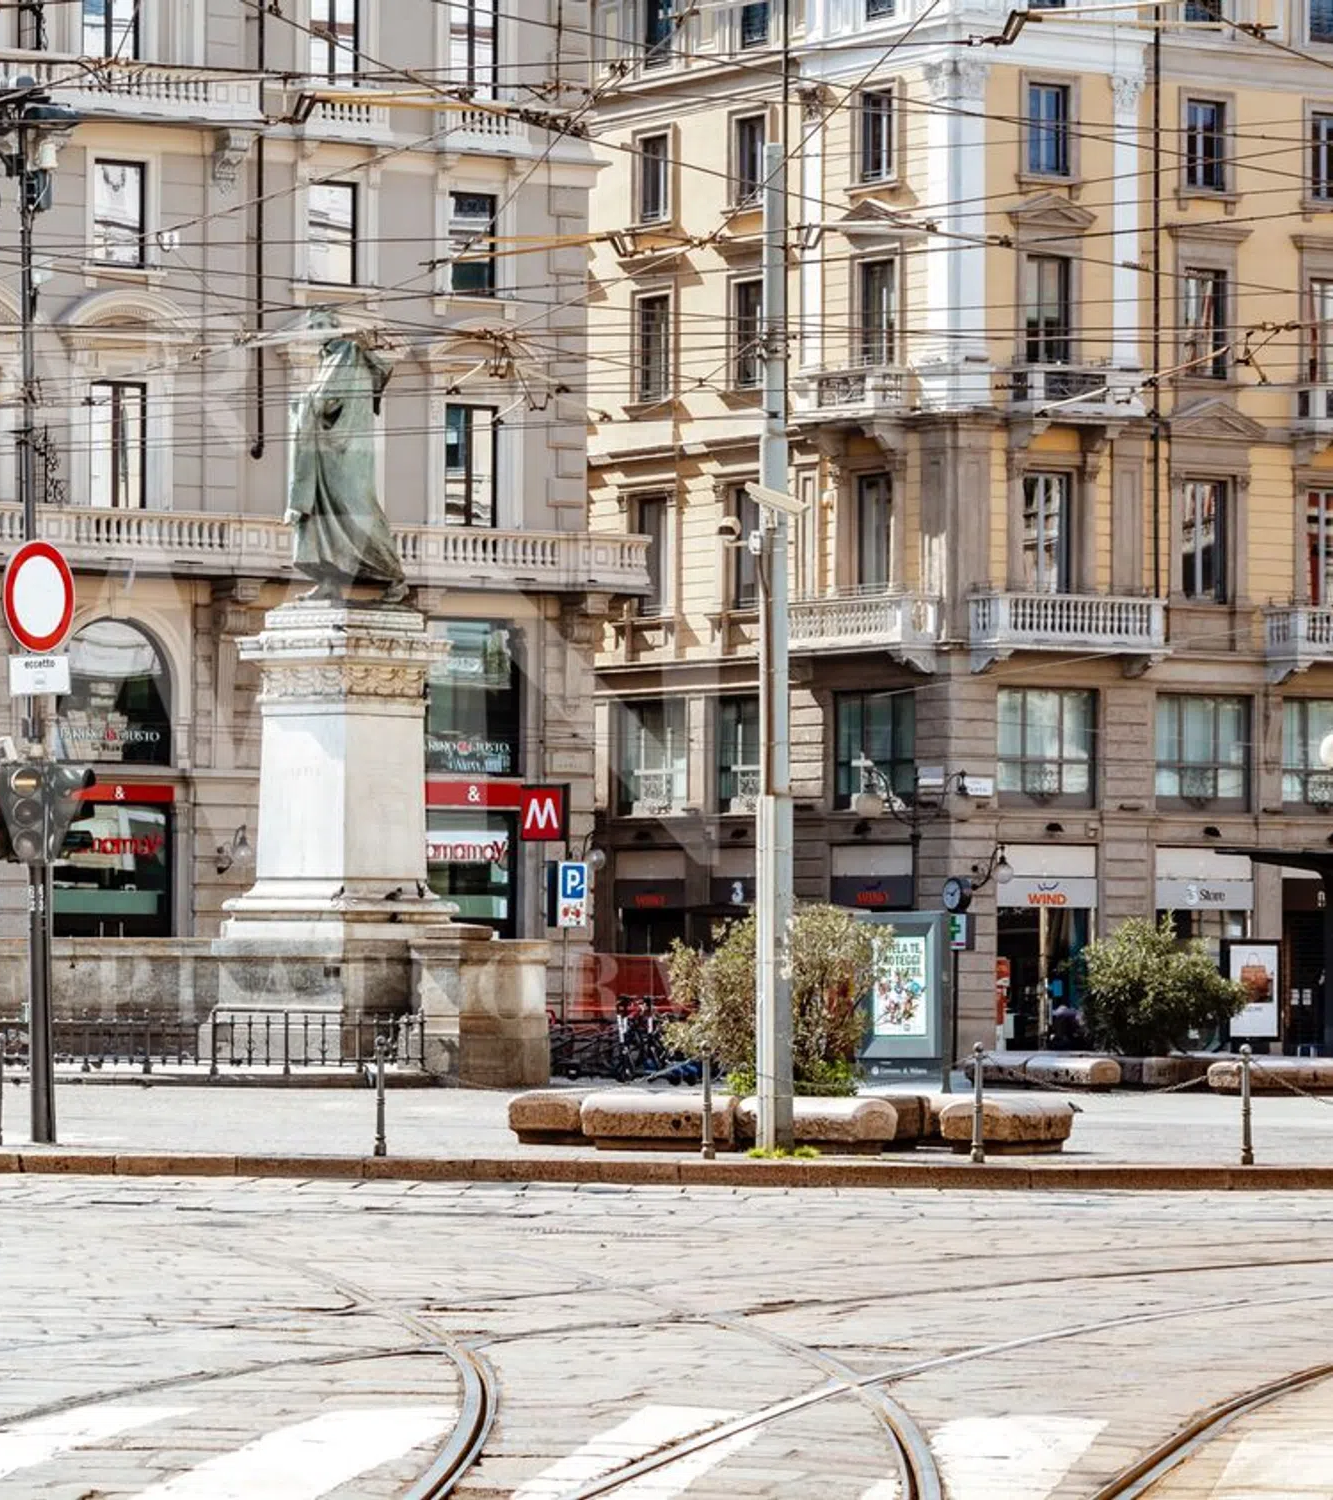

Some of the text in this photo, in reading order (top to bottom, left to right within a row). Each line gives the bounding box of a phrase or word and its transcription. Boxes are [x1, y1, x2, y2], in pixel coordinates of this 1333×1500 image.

[24, 658, 56, 669] eccetto
[114, 785, 125, 800] &
[467, 785, 481, 802] &
[524, 797, 558, 830] M
[566, 868, 581, 895] P
[731, 880, 744, 904] 3
[1027, 893, 1067, 905] WIND
[1199, 888, 1226, 902] Store
